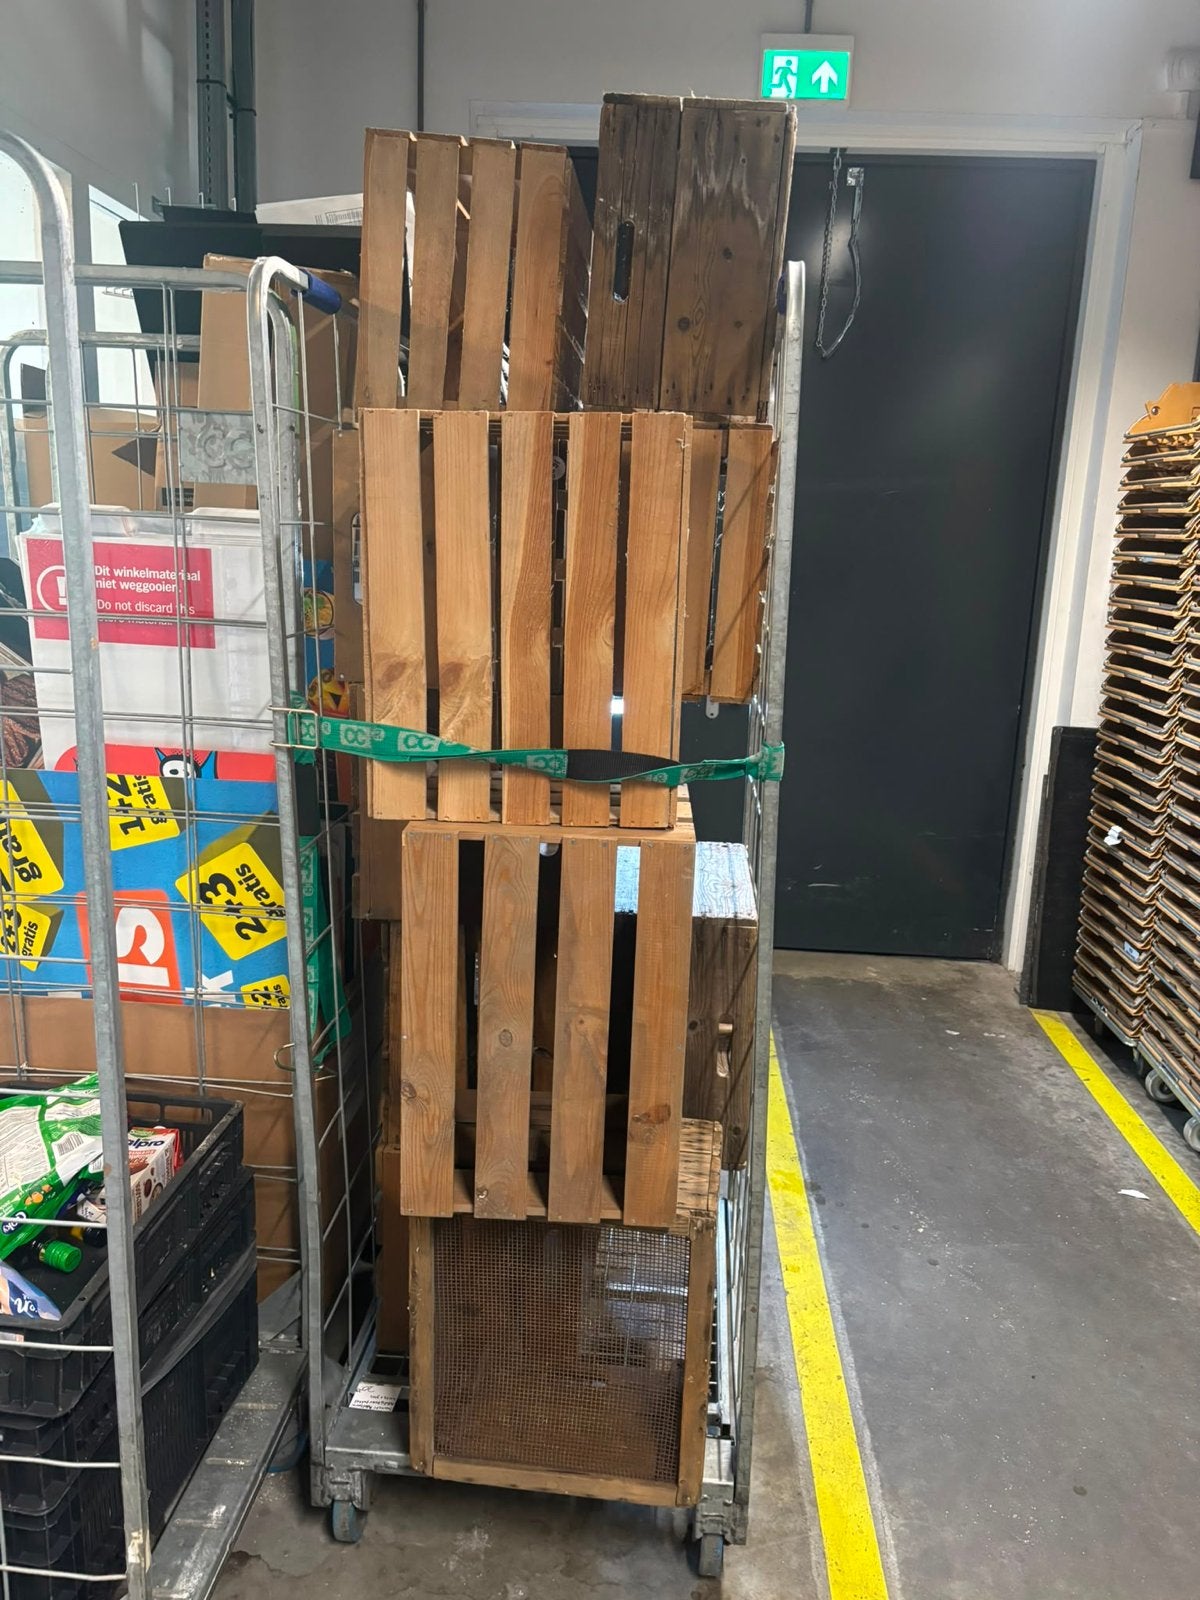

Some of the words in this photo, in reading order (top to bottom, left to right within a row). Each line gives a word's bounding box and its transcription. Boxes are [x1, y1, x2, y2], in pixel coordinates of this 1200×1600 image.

[95, 565, 110, 576] Dit
[95, 578, 117, 589] niet
[97, 599, 112, 610] Do
[115, 601, 132, 612] not
[135, 601, 173, 613] discard
[344, 726, 366, 745] CC
[403, 733, 435, 750] CC
[235, 863, 286, 921] gratis
[200, 873, 268, 940] 2+3
[22, 921, 39, 957] gratis
[128, 1139, 164, 1149] alpro
